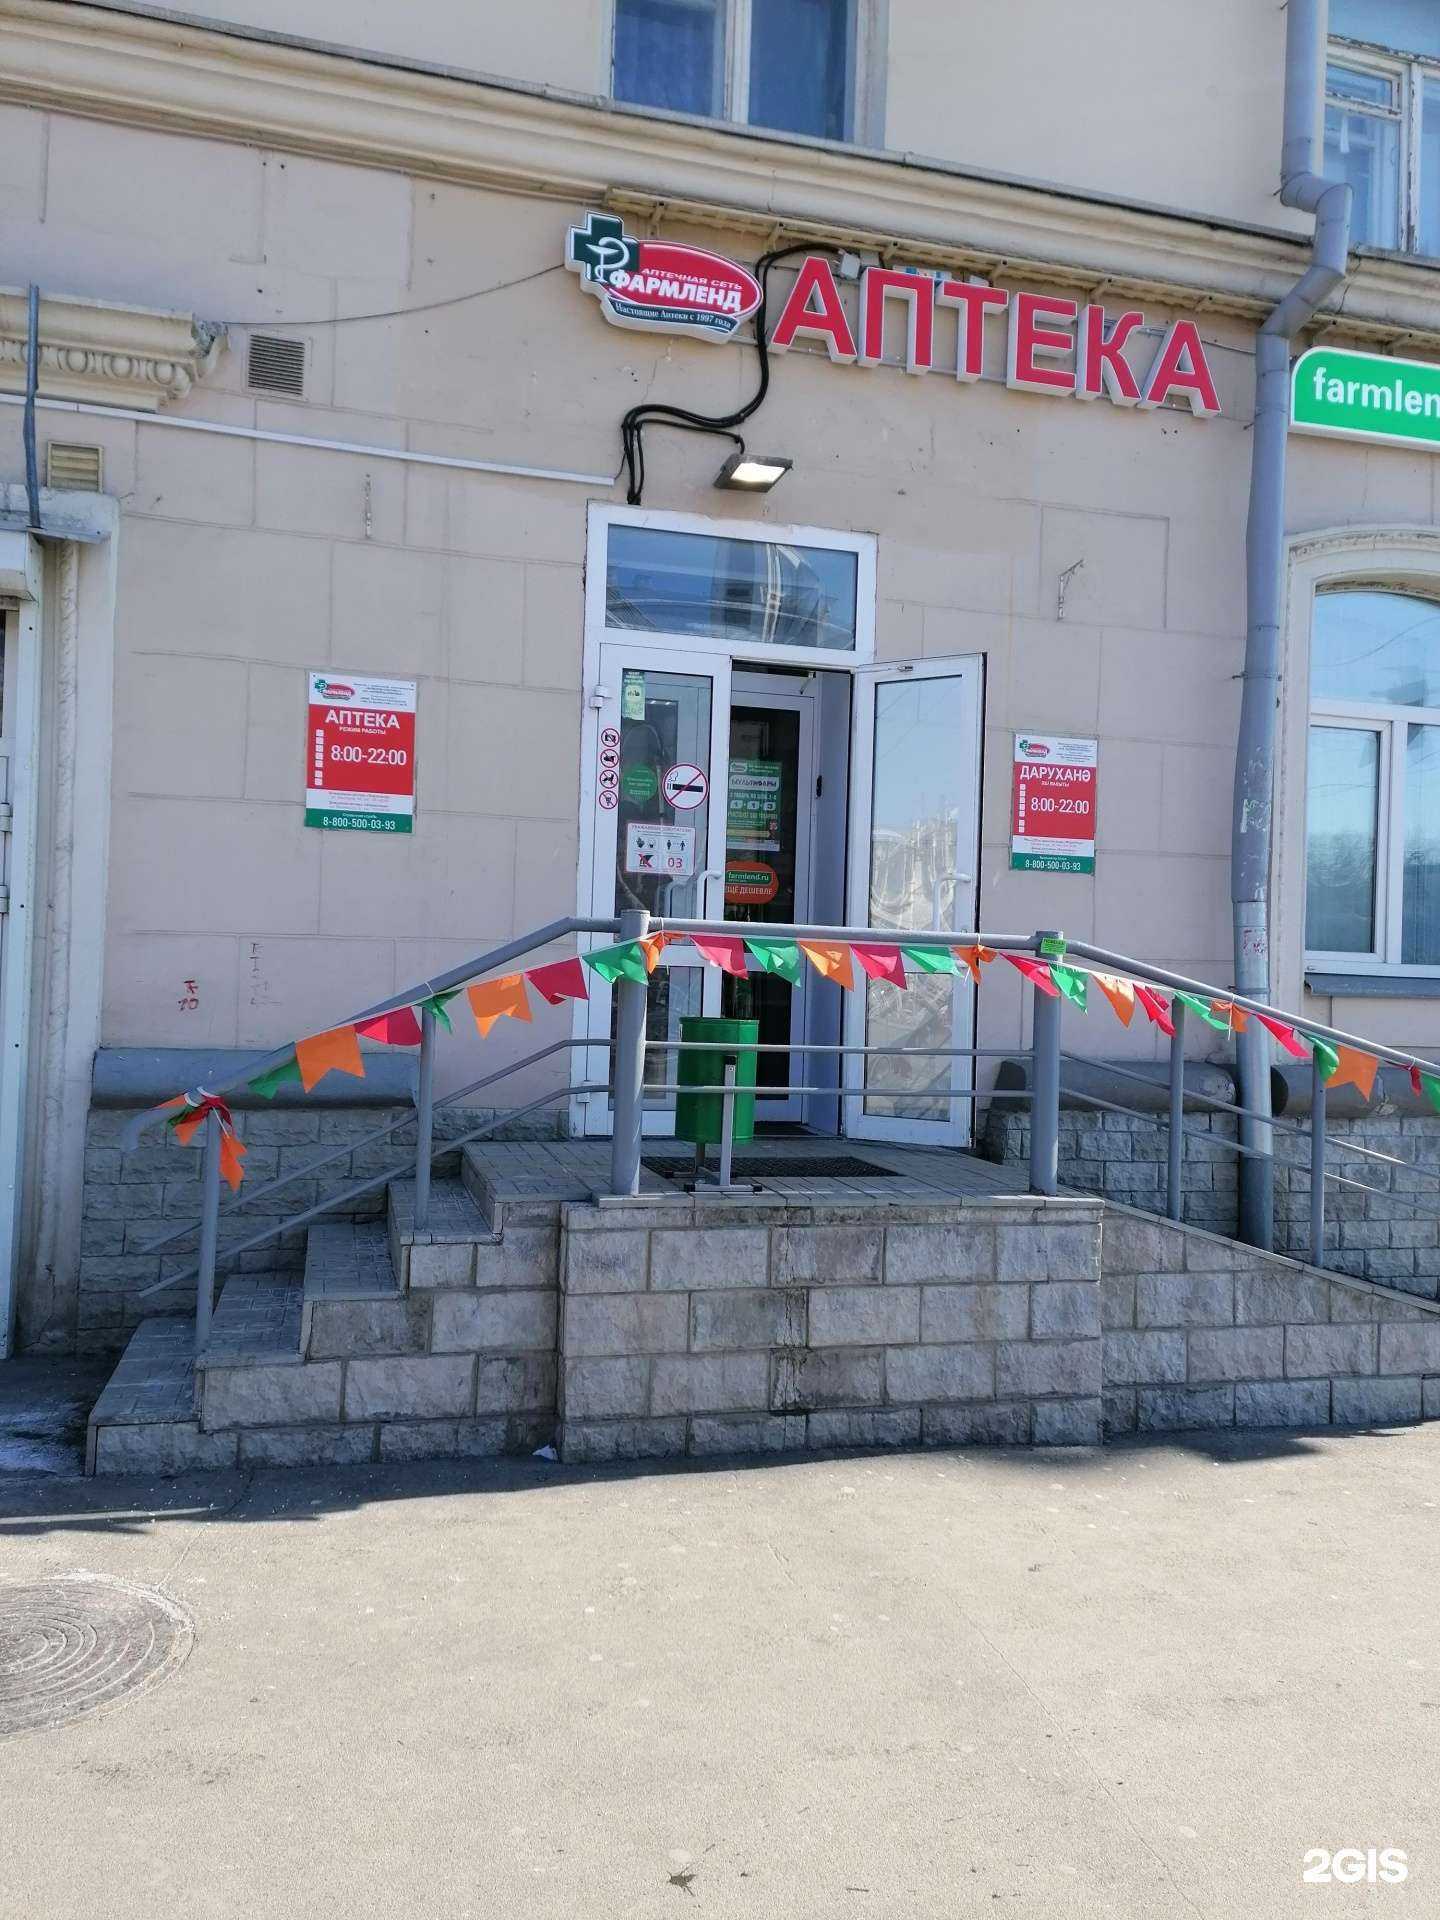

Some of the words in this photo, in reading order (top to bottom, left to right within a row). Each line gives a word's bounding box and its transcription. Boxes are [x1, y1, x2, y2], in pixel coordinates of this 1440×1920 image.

[641, 268, 708, 285] АПТЕЧНАЯ
[711, 280, 743, 290] СЕТЬ
[609, 269, 742, 312] ФАРМЛЕНД
[615, 303, 659, 318] Настоящие
[660, 310, 688, 320] Аптеки
[696, 313, 714, 323] 1997
[771, 256, 1221, 416] АПТЕКА
[325, 709, 400, 729] АПТЕКА
[331, 745, 407, 766] 8:00-22:00
[1031, 797, 1089, 814] 8:00-22:00
[323, 816, 396, 830] 8-800-500-03-93
[667, 857, 683, 869] 03
[728, 871, 769, 881] farmlend.ru
[740, 886, 773, 895] ДЕШЕВЛЕ
